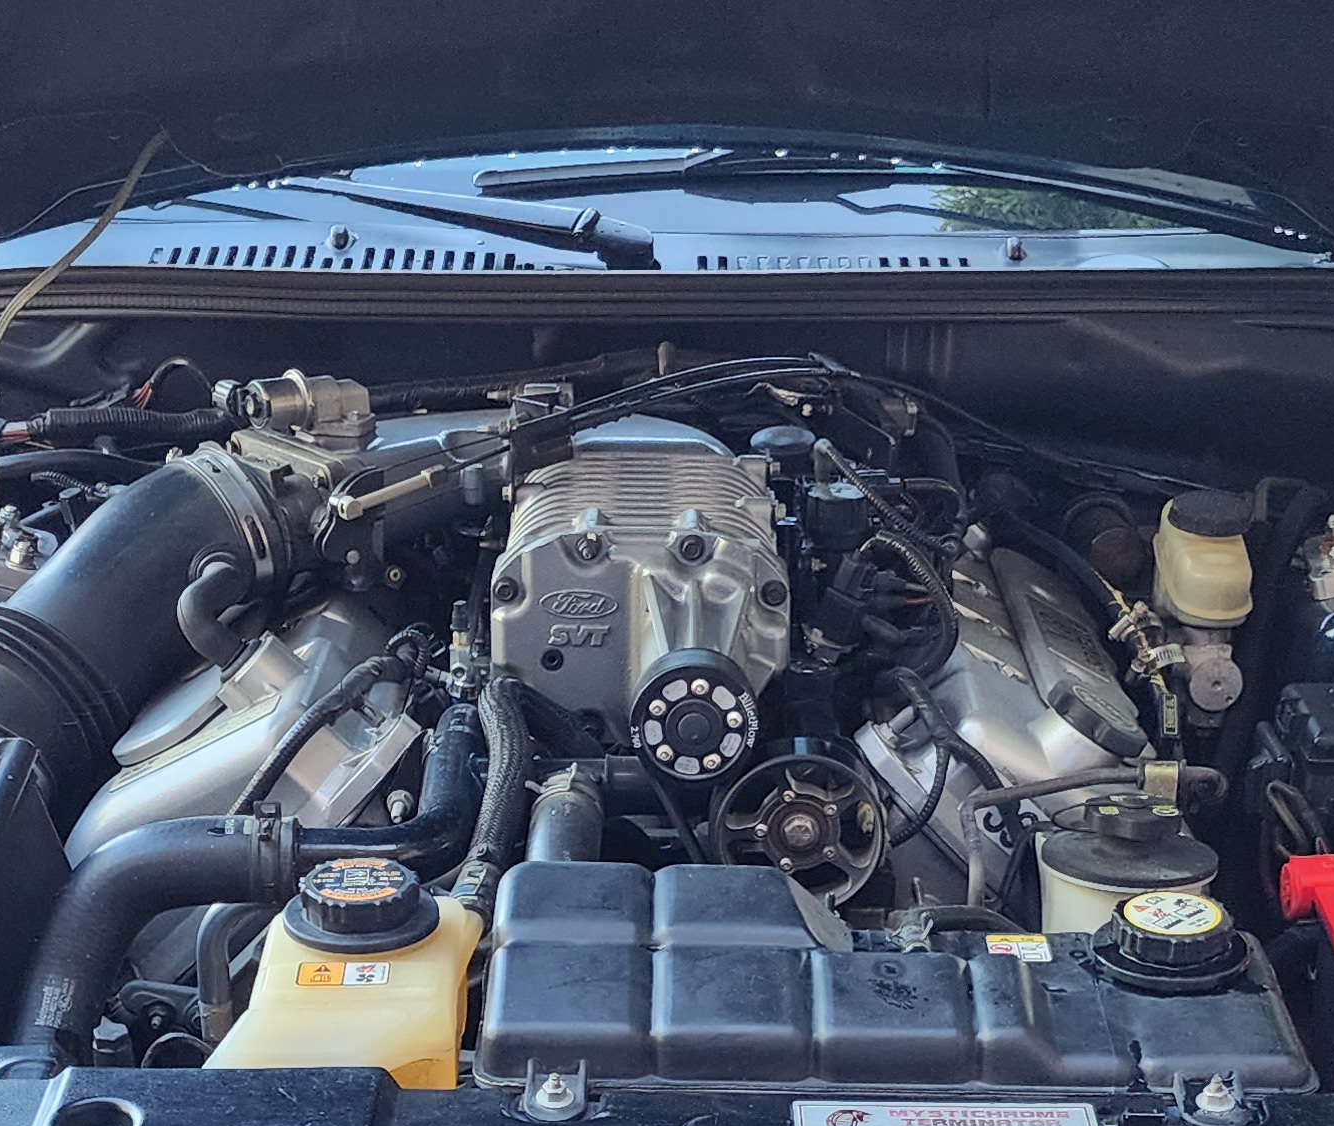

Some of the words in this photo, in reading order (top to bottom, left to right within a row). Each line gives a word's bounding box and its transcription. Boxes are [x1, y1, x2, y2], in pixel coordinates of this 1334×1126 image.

[551, 593, 607, 615] Ford
[548, 624, 611, 647] SVT
[738, 691, 759, 749] BilletFlow
[889, 1110, 1070, 1118] MYSTICHROME
[901, 1119, 1062, 1126] TERMINATOR
